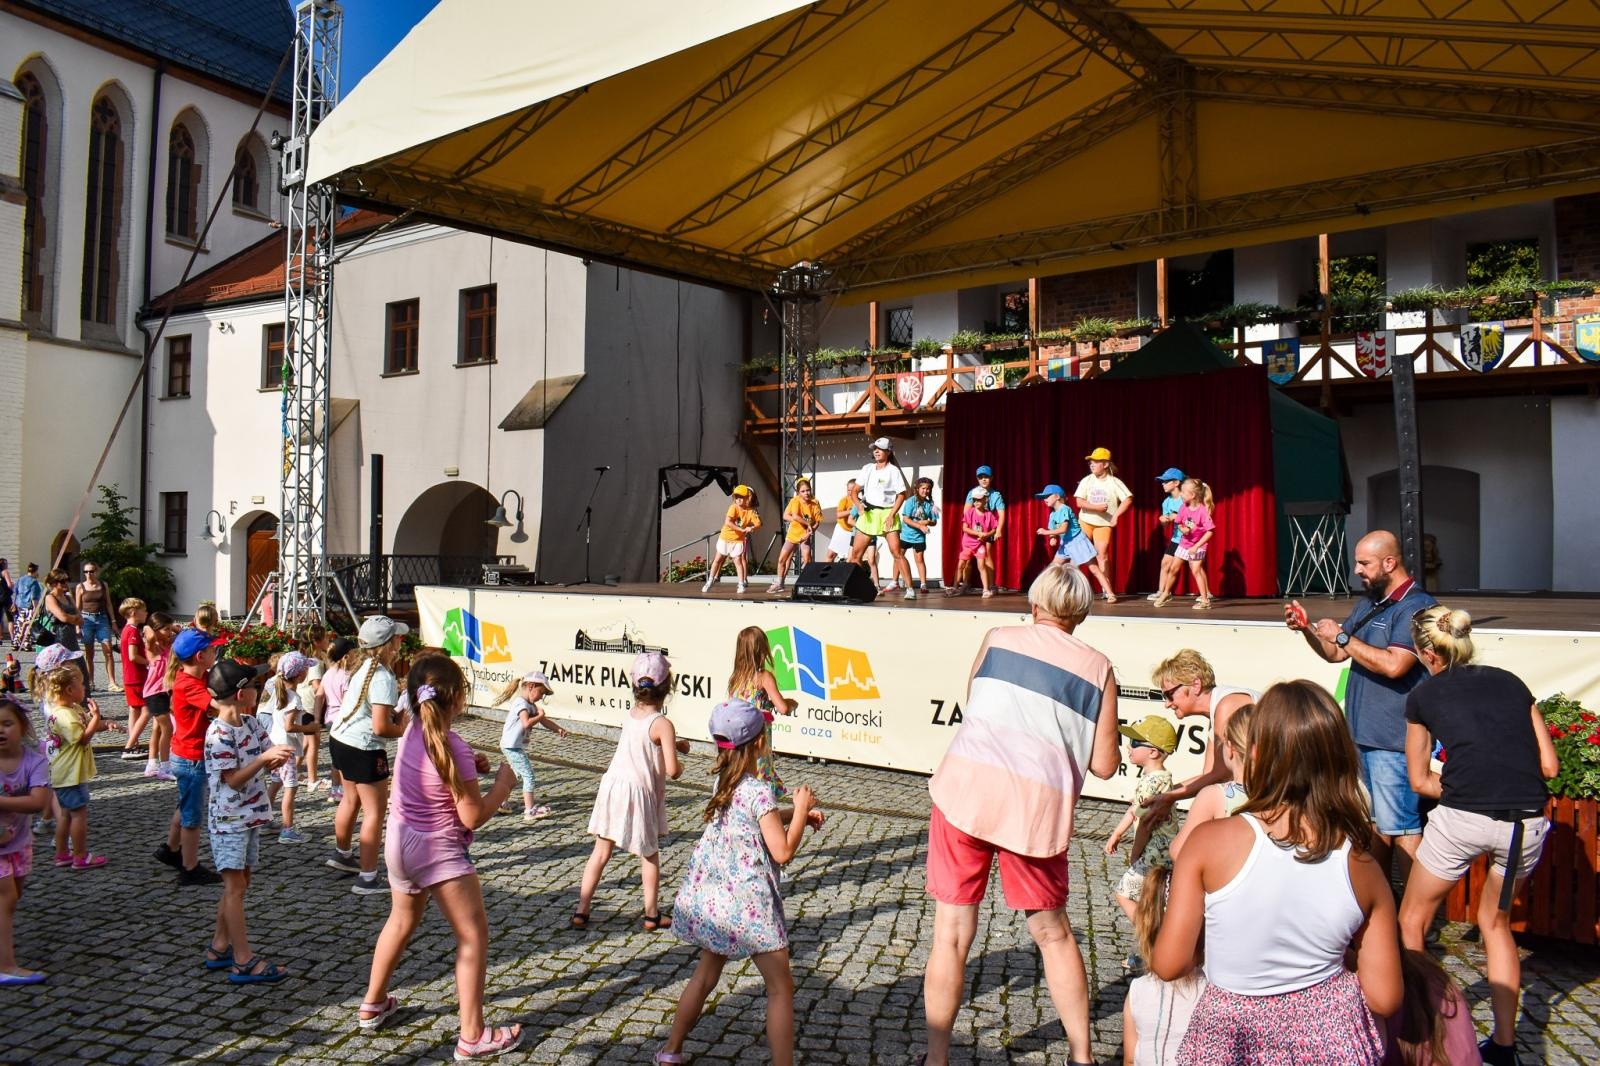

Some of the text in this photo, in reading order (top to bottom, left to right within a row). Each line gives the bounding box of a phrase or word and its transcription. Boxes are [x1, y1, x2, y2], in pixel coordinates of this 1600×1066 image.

[230, 500, 238, 515] F
[539, 660, 712, 699] ZAMEK PIASKI
[575, 694, 668, 716] W RACIBU
[807, 705, 882, 728] raciborski
[800, 726, 832, 739] oaza
[841, 729, 882, 744] kultur
